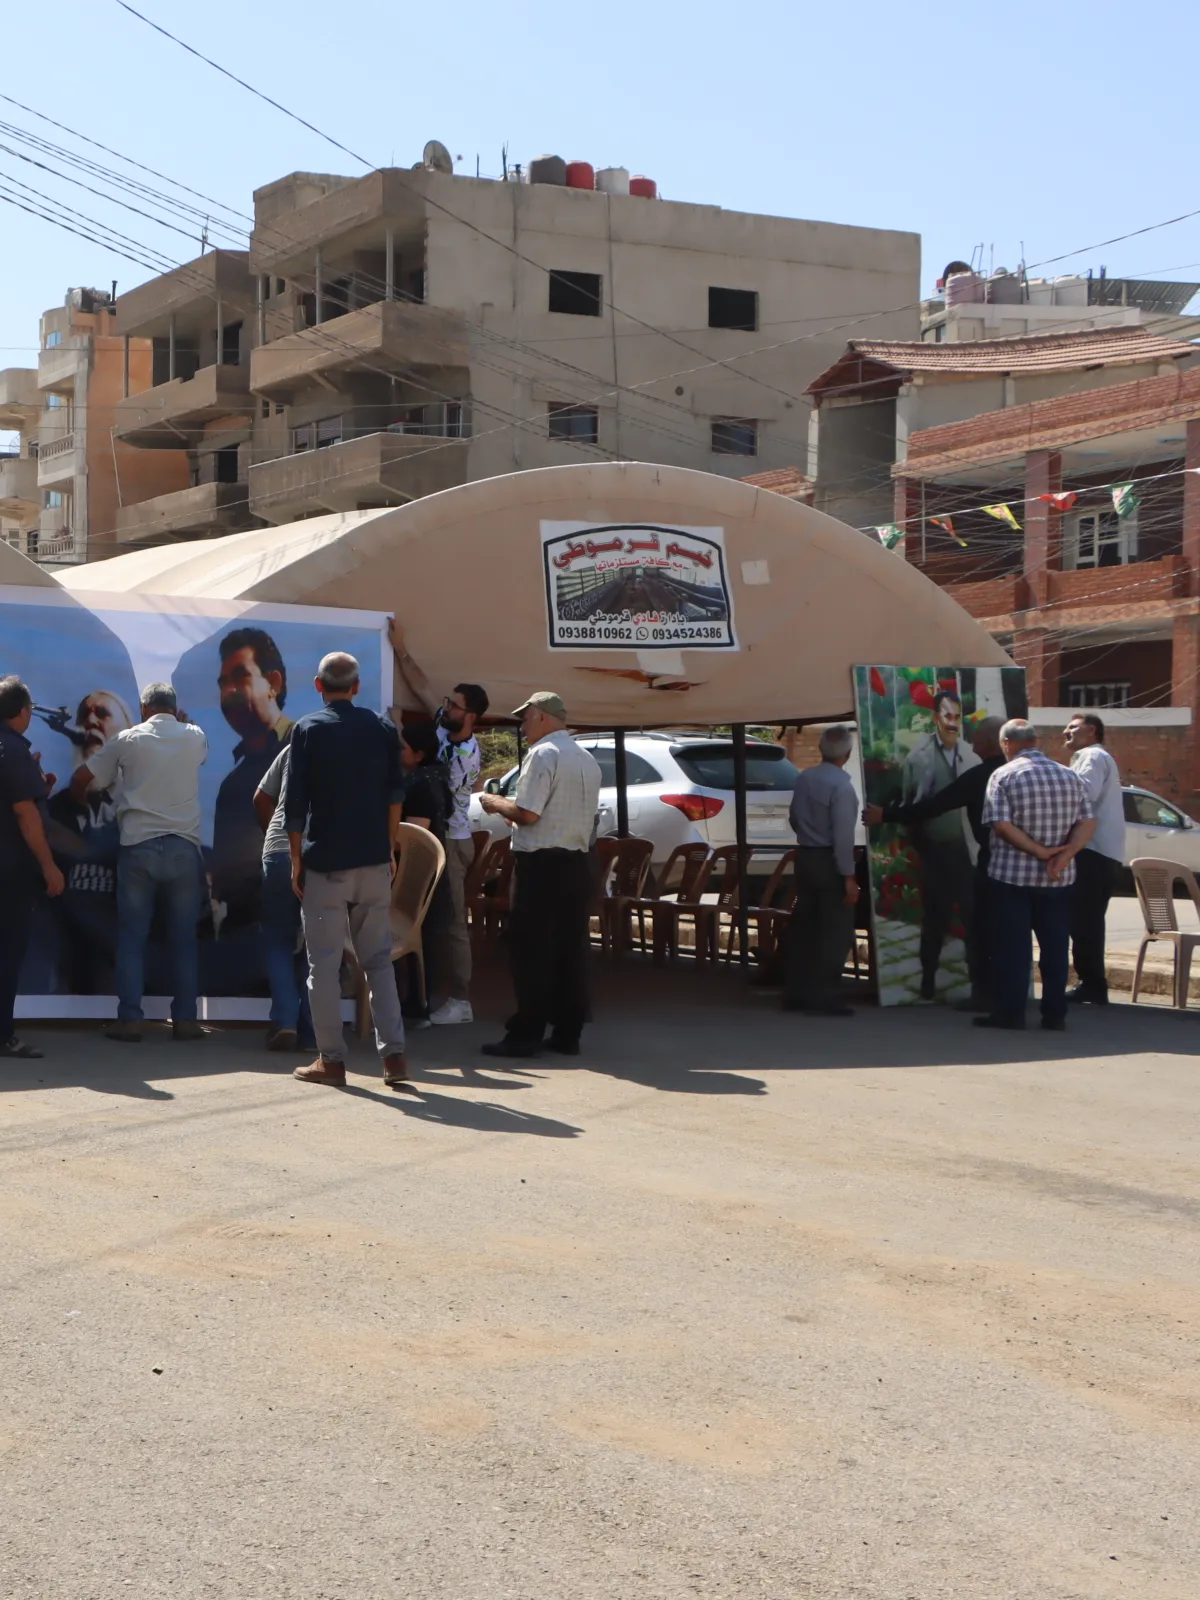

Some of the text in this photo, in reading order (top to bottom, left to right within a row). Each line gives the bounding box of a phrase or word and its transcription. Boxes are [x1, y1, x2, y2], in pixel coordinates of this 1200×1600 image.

[553, 534, 713, 571] خيم قرموطي
[588, 609, 630, 625] قرموطي
[633, 612, 659, 625] فادي
[558, 627, 722, 640] 0938810962 0934524386
